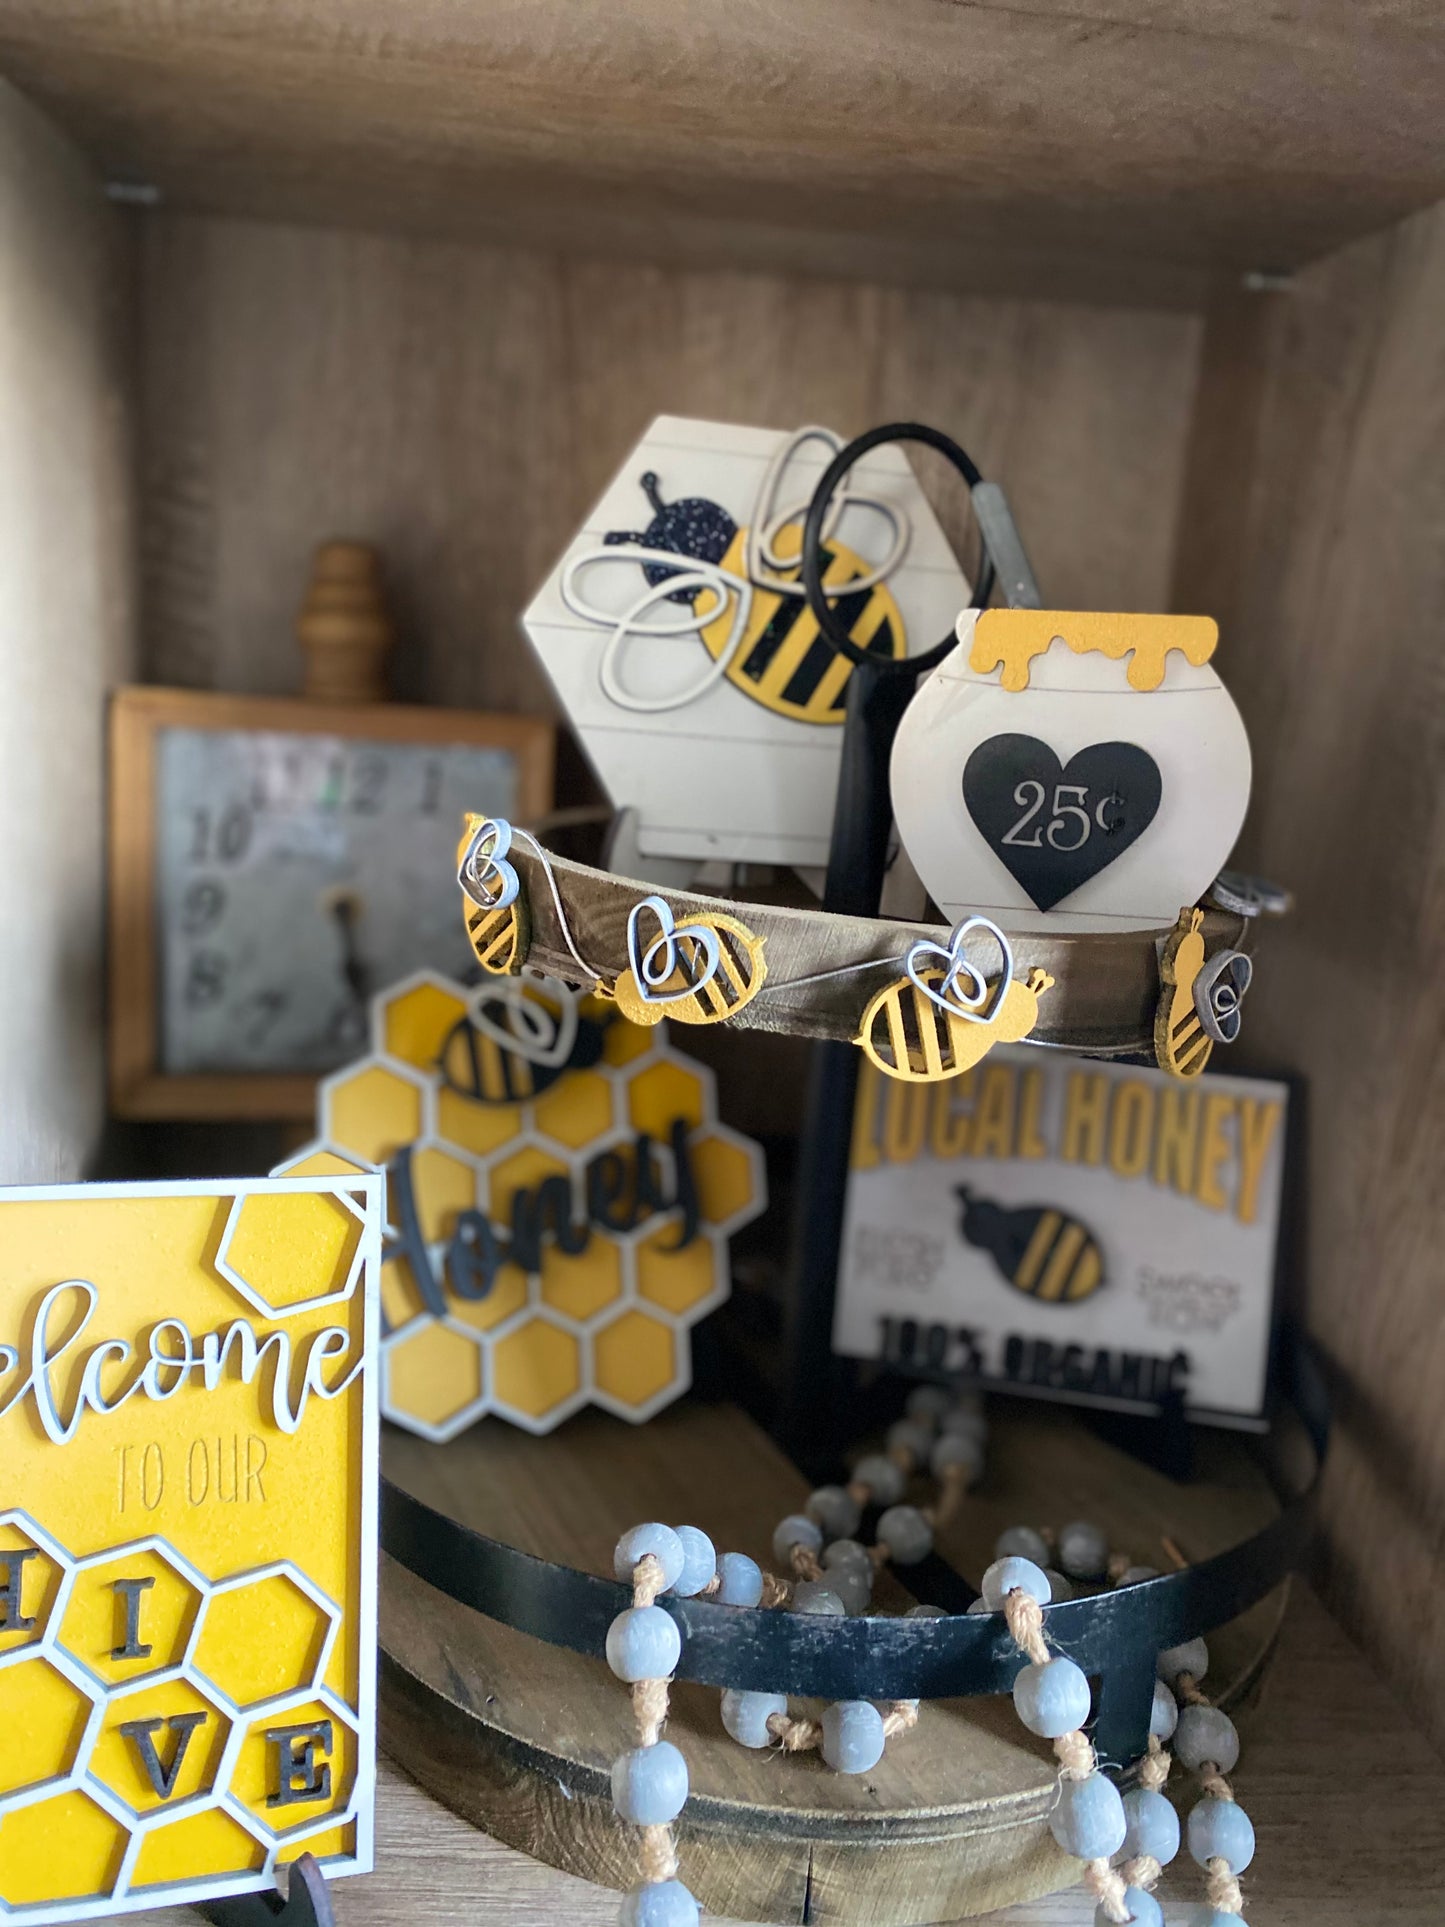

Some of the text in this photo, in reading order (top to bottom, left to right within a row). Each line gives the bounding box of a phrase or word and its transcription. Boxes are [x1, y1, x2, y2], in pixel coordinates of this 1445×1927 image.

[850, 1054, 1280, 1226] LOCAL HONEY
[112, 1433, 268, 1514] TO OUR
